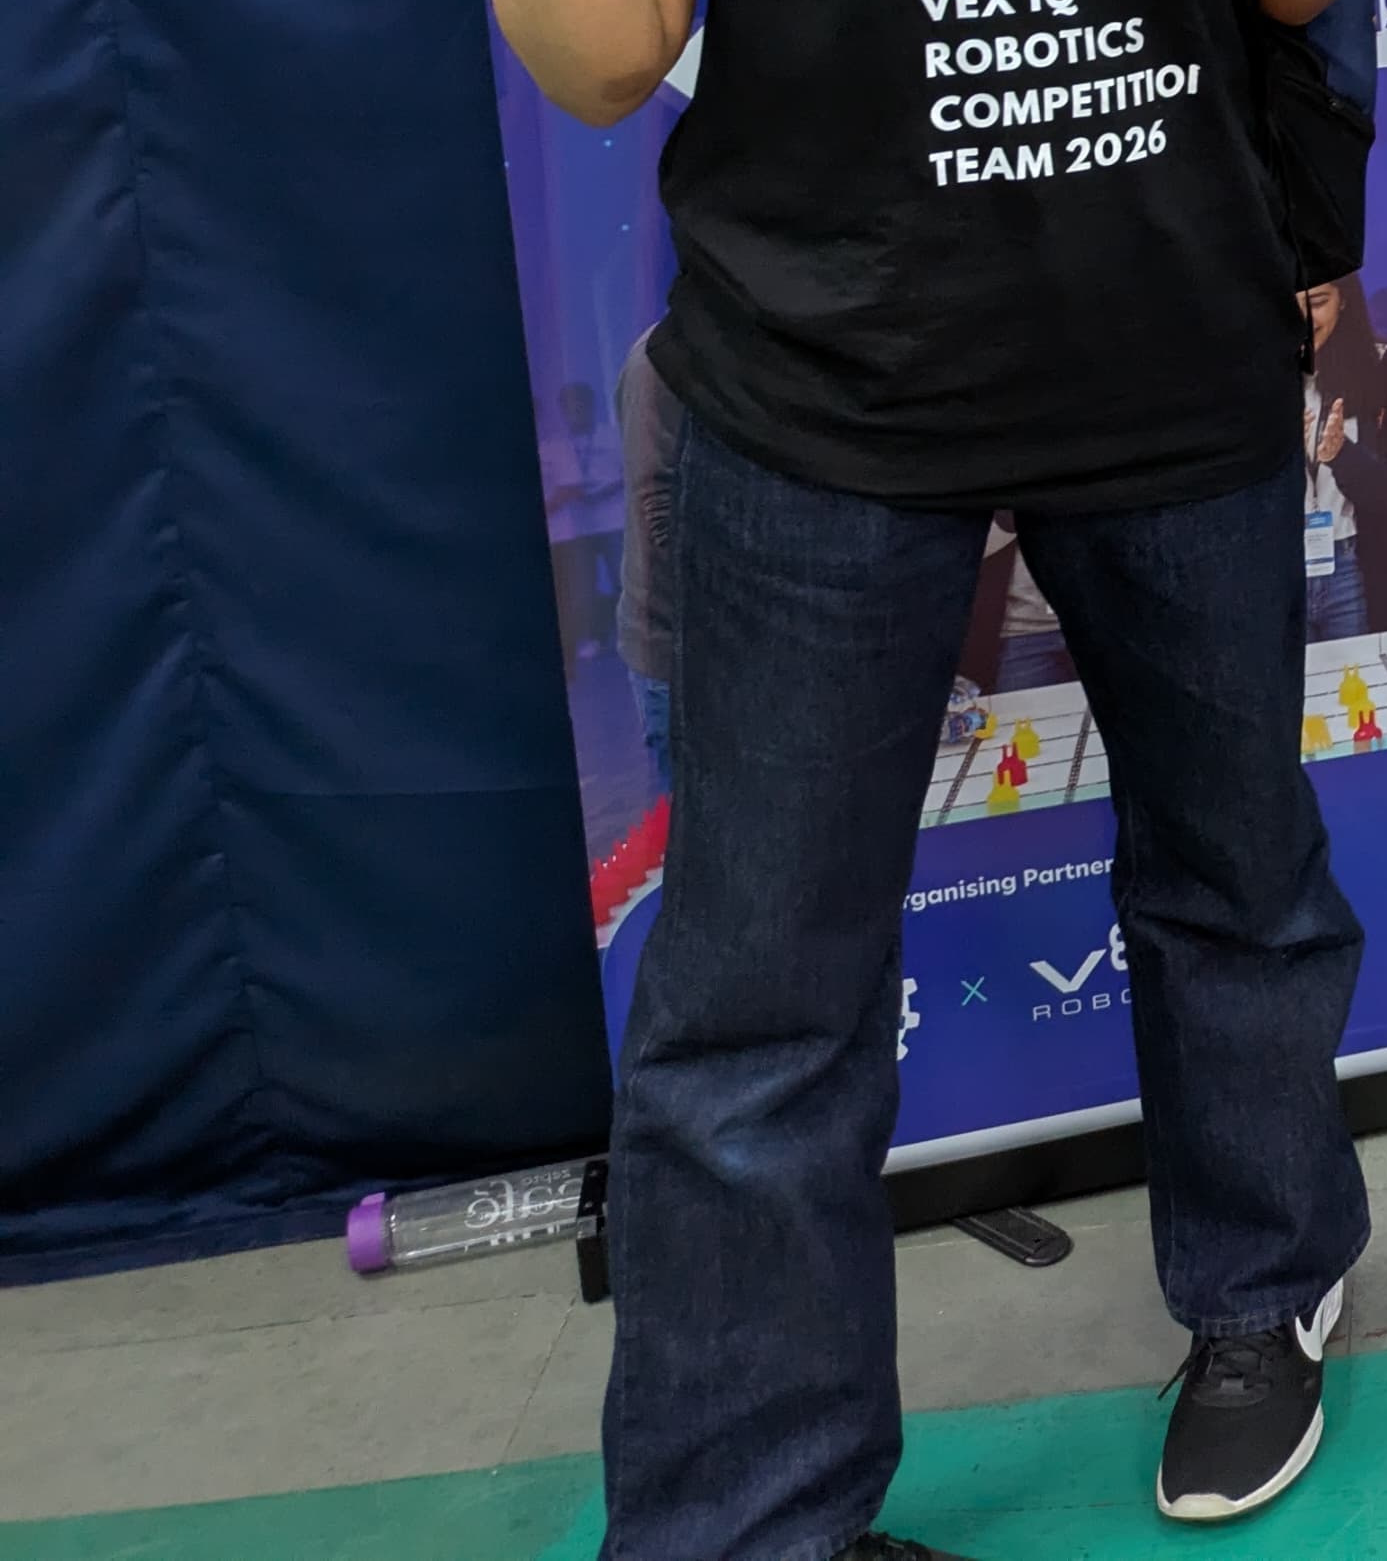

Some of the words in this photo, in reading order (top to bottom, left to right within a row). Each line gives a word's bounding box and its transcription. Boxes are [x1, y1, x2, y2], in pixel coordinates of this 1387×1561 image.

[924, 17, 1145, 79] ROBOTICS
[928, 143, 1055, 187] TEAM
[1064, 119, 1168, 174] 2026
[902, 875, 1018, 912] rganising
